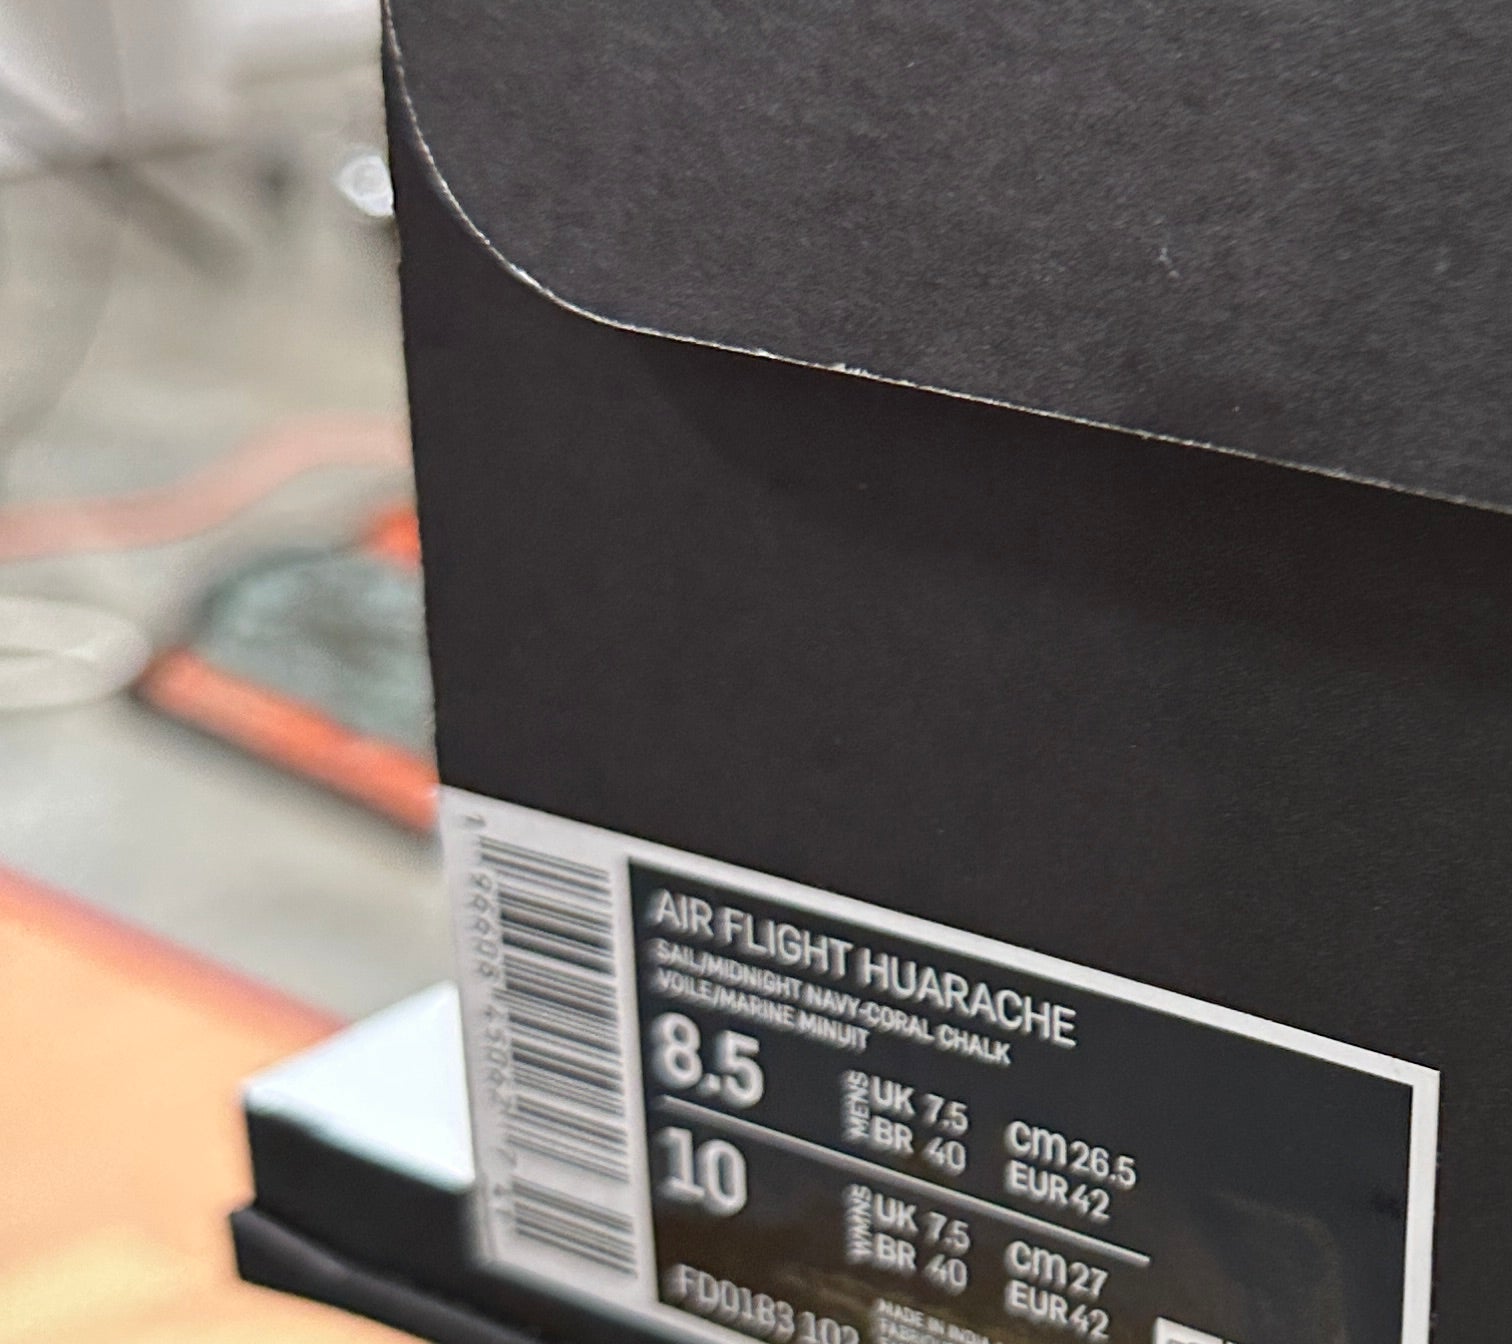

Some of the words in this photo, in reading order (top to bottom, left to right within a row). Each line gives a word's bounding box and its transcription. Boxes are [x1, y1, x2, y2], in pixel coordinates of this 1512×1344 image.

[651, 888, 714, 939] AIR
[715, 906, 854, 979] FLIGHT
[856, 947, 1077, 1049] HUARACHE
[651, 938, 803, 1001] SAIL/MIDNIGHT
[803, 982, 935, 1044] NAVY-CORAL
[935, 1023, 1011, 1067] CHALK
[653, 967, 797, 1029] VOILE/MARINE
[797, 1009, 870, 1054] MINUIT
[652, 1012, 764, 1108] 8.5
[841, 1069, 870, 1142] MENS
[870, 1075, 915, 1120] UK
[919, 1093, 969, 1136] 7.5
[654, 1126, 748, 1217] 10
[869, 1115, 915, 1157] BR
[922, 1136, 967, 1176] 40
[872, 1193, 918, 1236] UK
[872, 1232, 917, 1276] BR
[923, 1254, 968, 1296] 40
[876, 1298, 924, 1327] MADE
